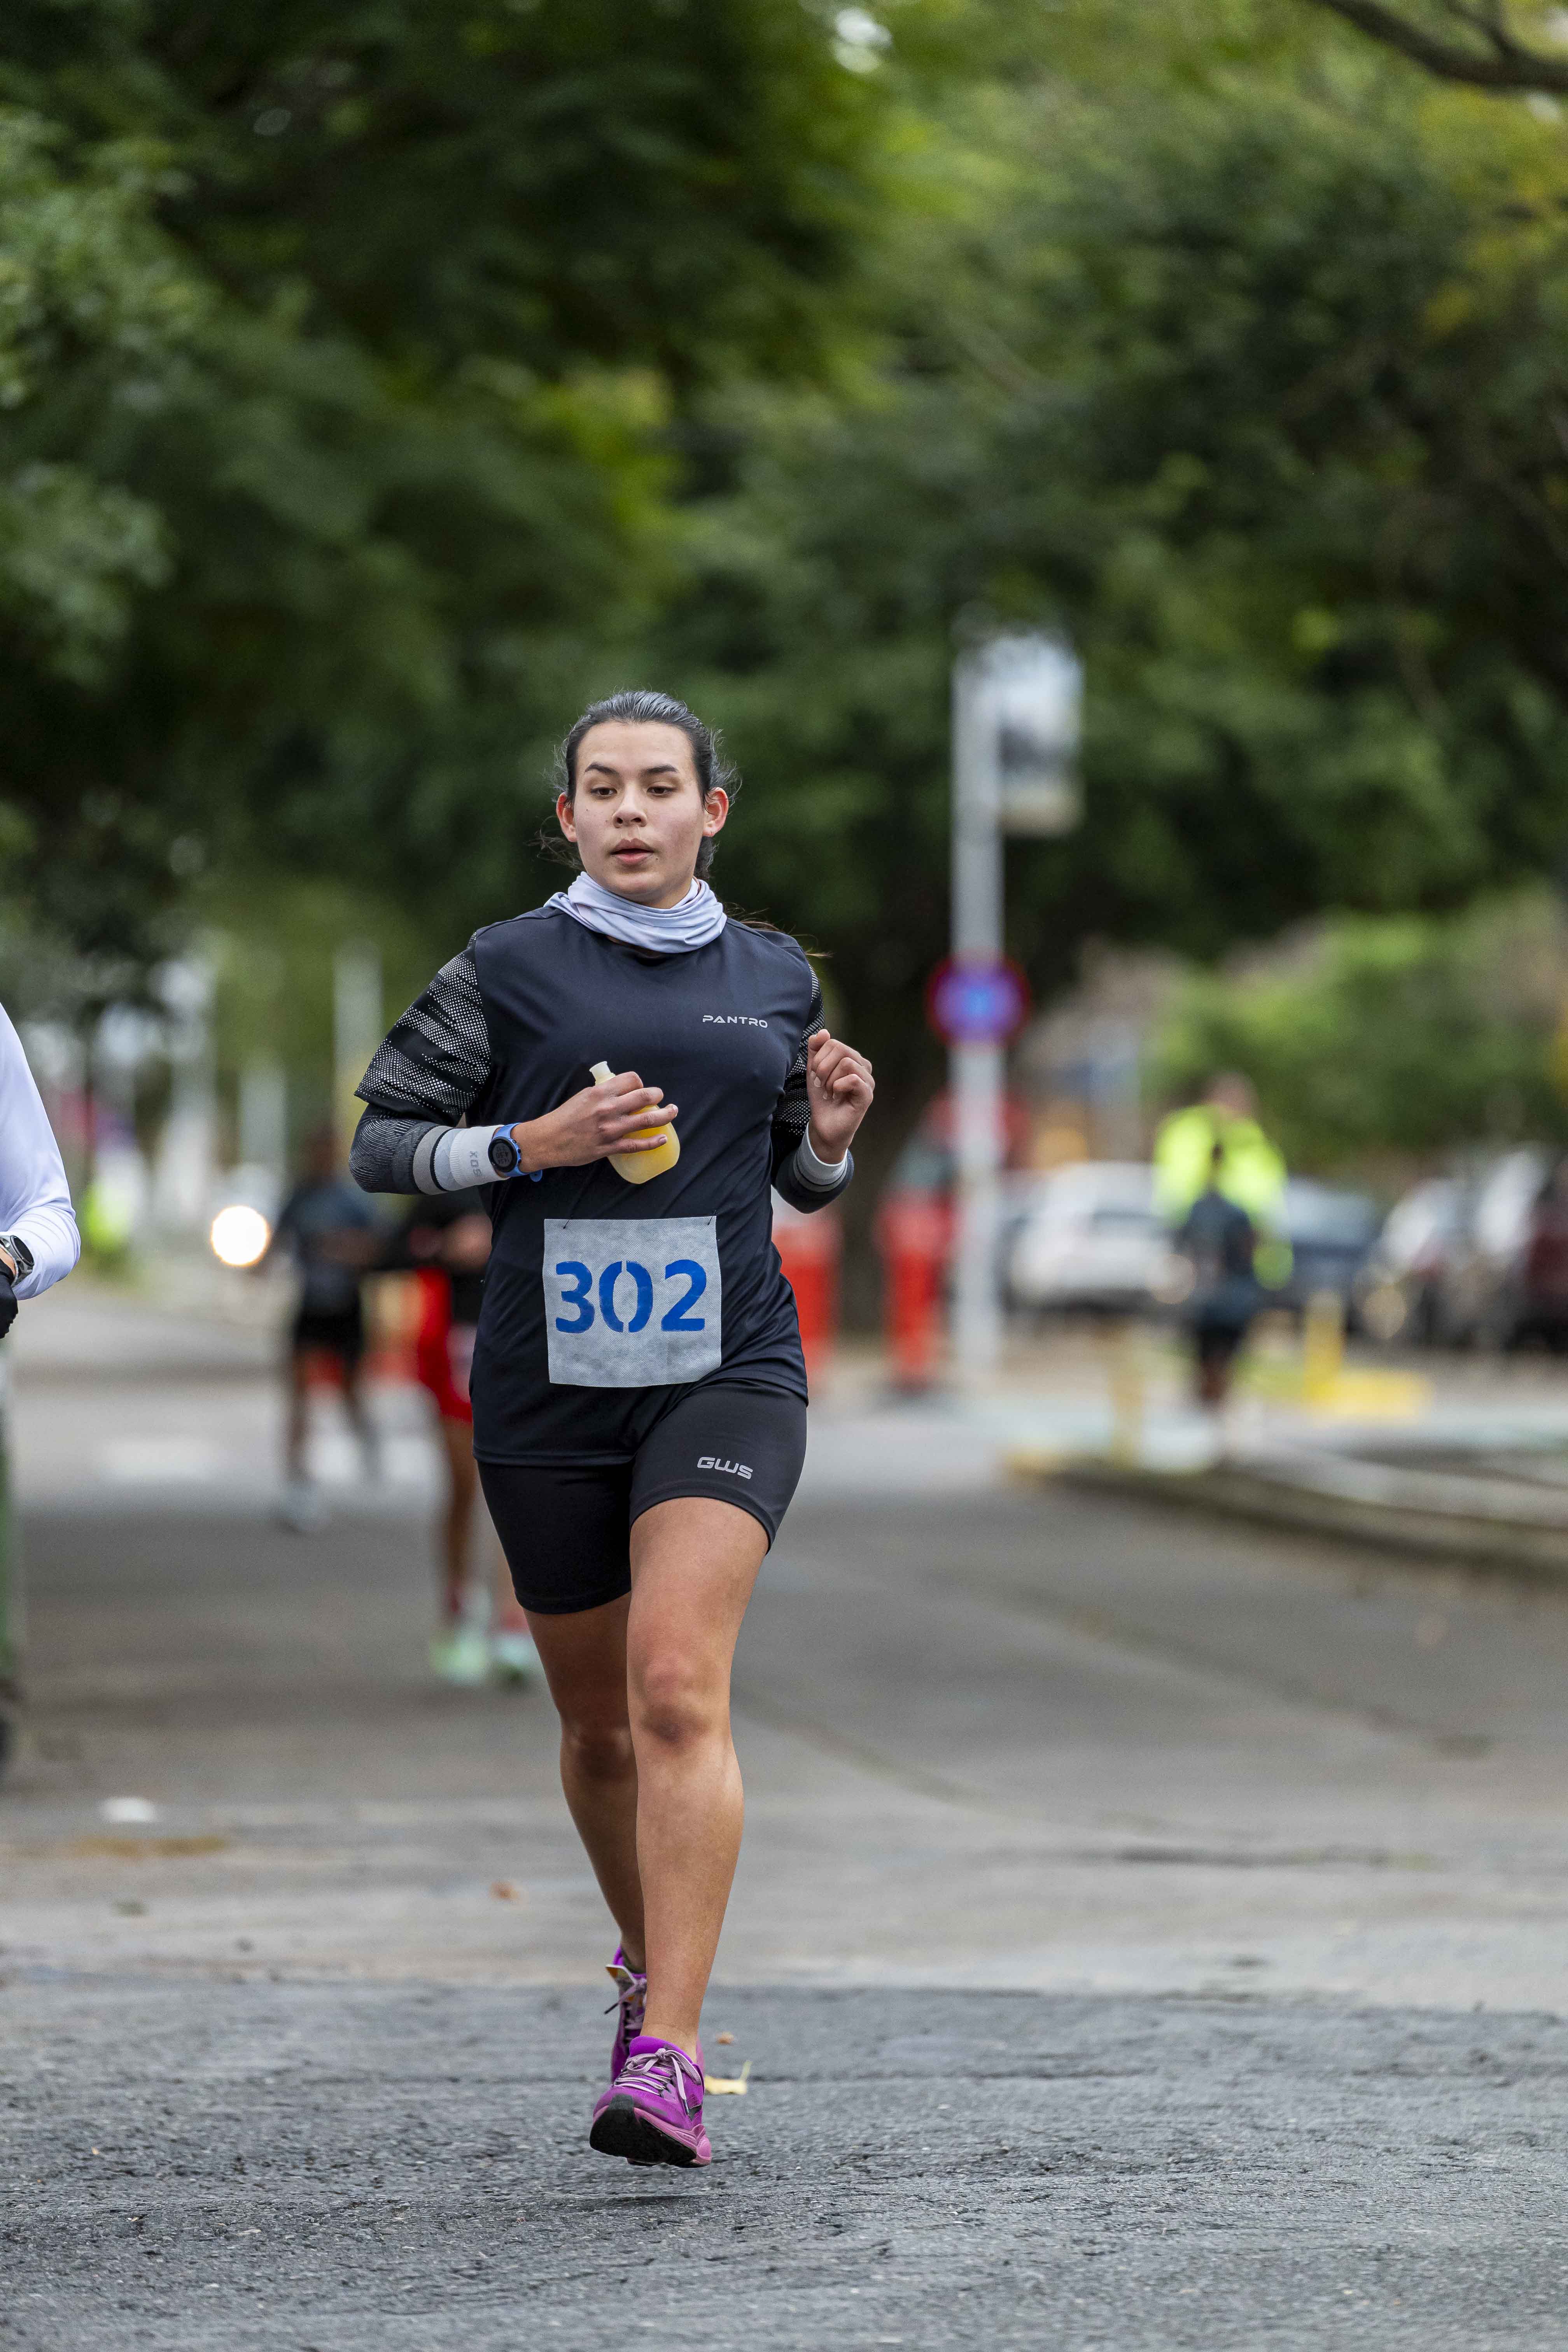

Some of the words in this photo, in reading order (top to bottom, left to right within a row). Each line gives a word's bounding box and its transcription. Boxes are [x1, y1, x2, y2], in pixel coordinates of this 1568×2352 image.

[702, 1015, 768, 1028] PANTRO
[555, 1259, 707, 1334] 302
[697, 1457, 753, 1479] GWS
